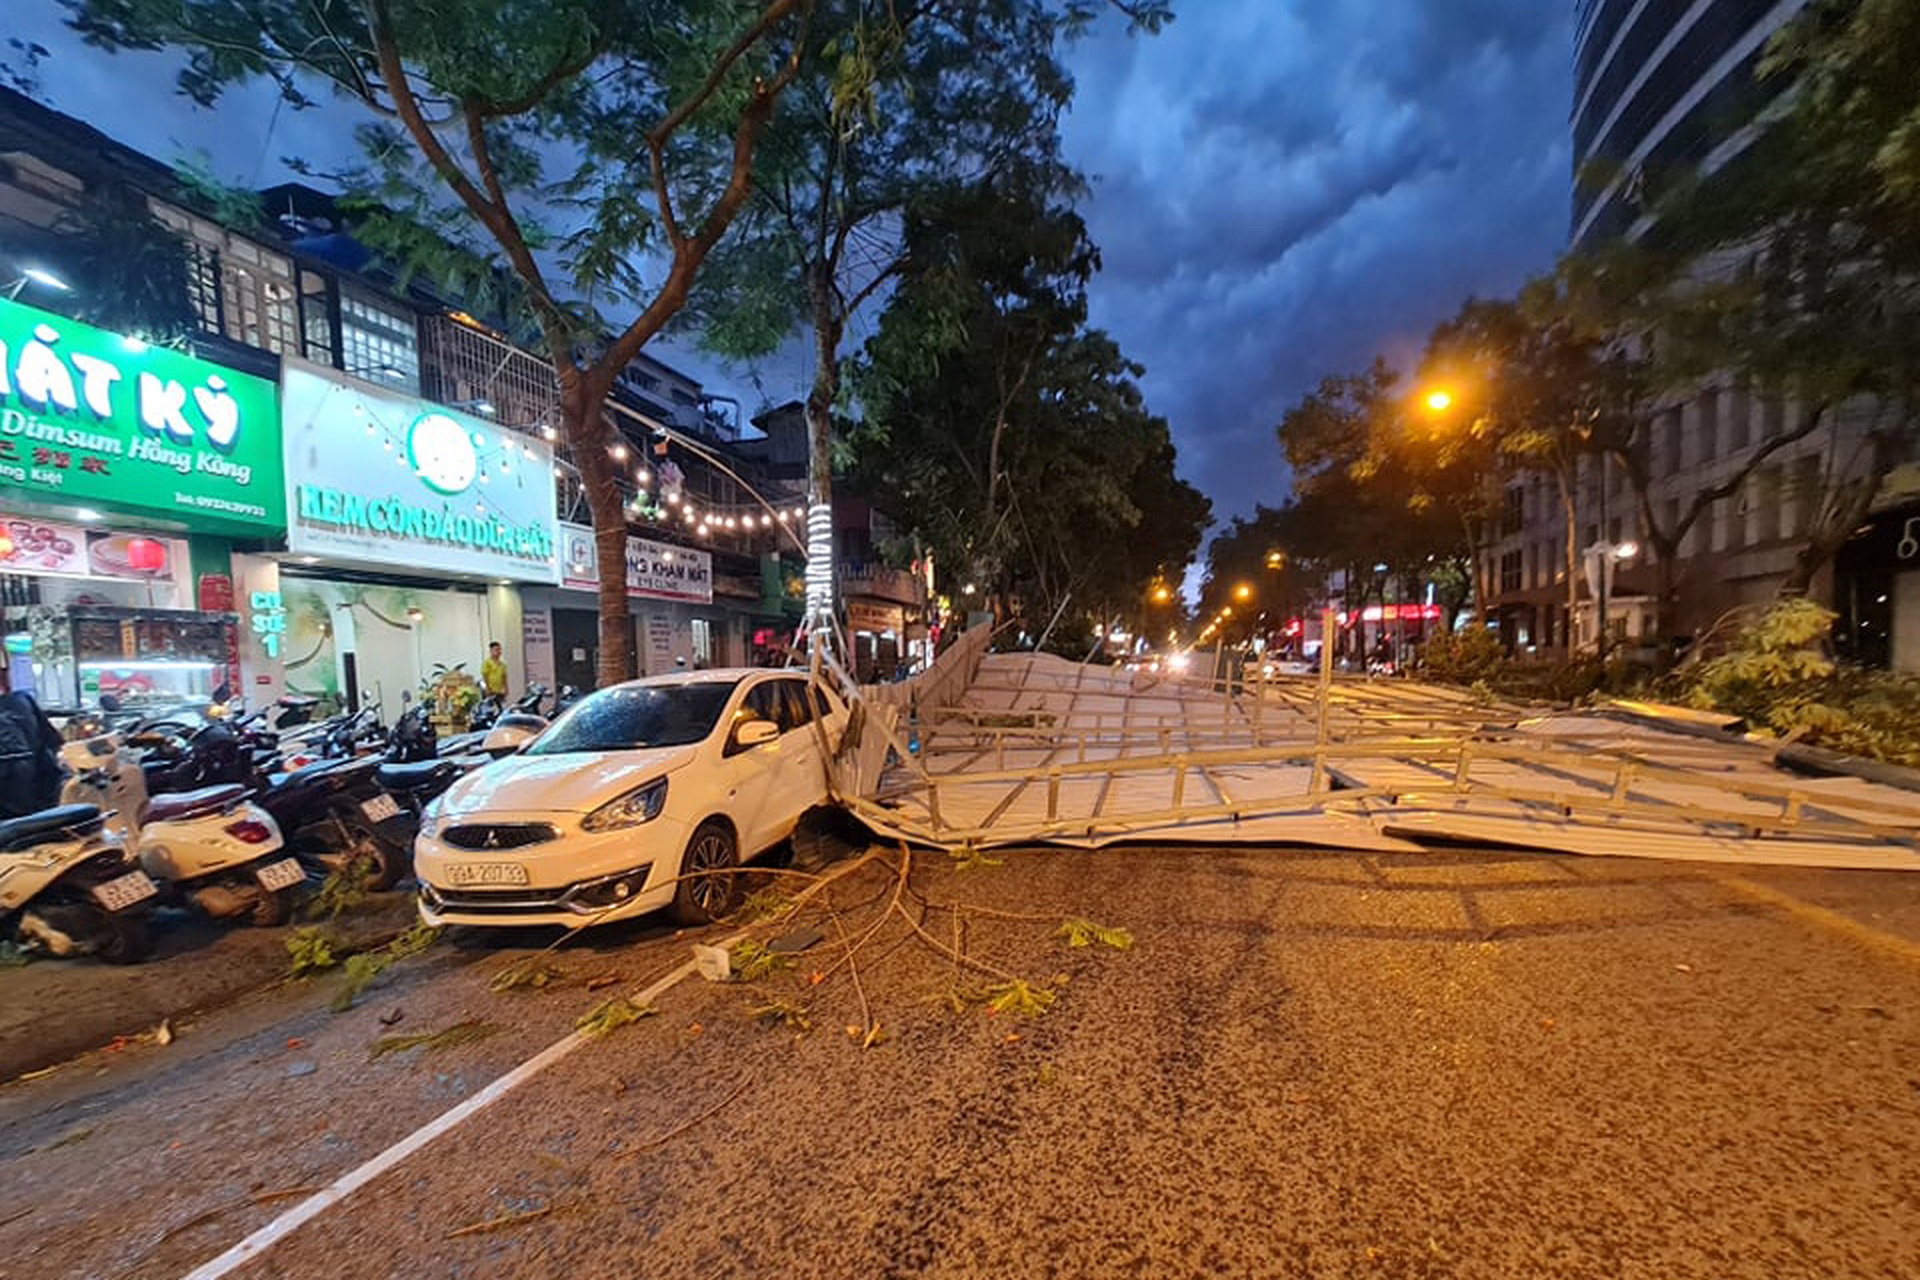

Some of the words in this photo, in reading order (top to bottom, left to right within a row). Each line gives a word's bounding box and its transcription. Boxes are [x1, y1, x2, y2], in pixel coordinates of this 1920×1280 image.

[2, 410, 122, 455] Dimsum
[128, 436, 192, 474] Hồng
[196, 449, 251, 485] Kông
[299, 484, 367, 530] KEM
[262, 634, 277, 657] 1
